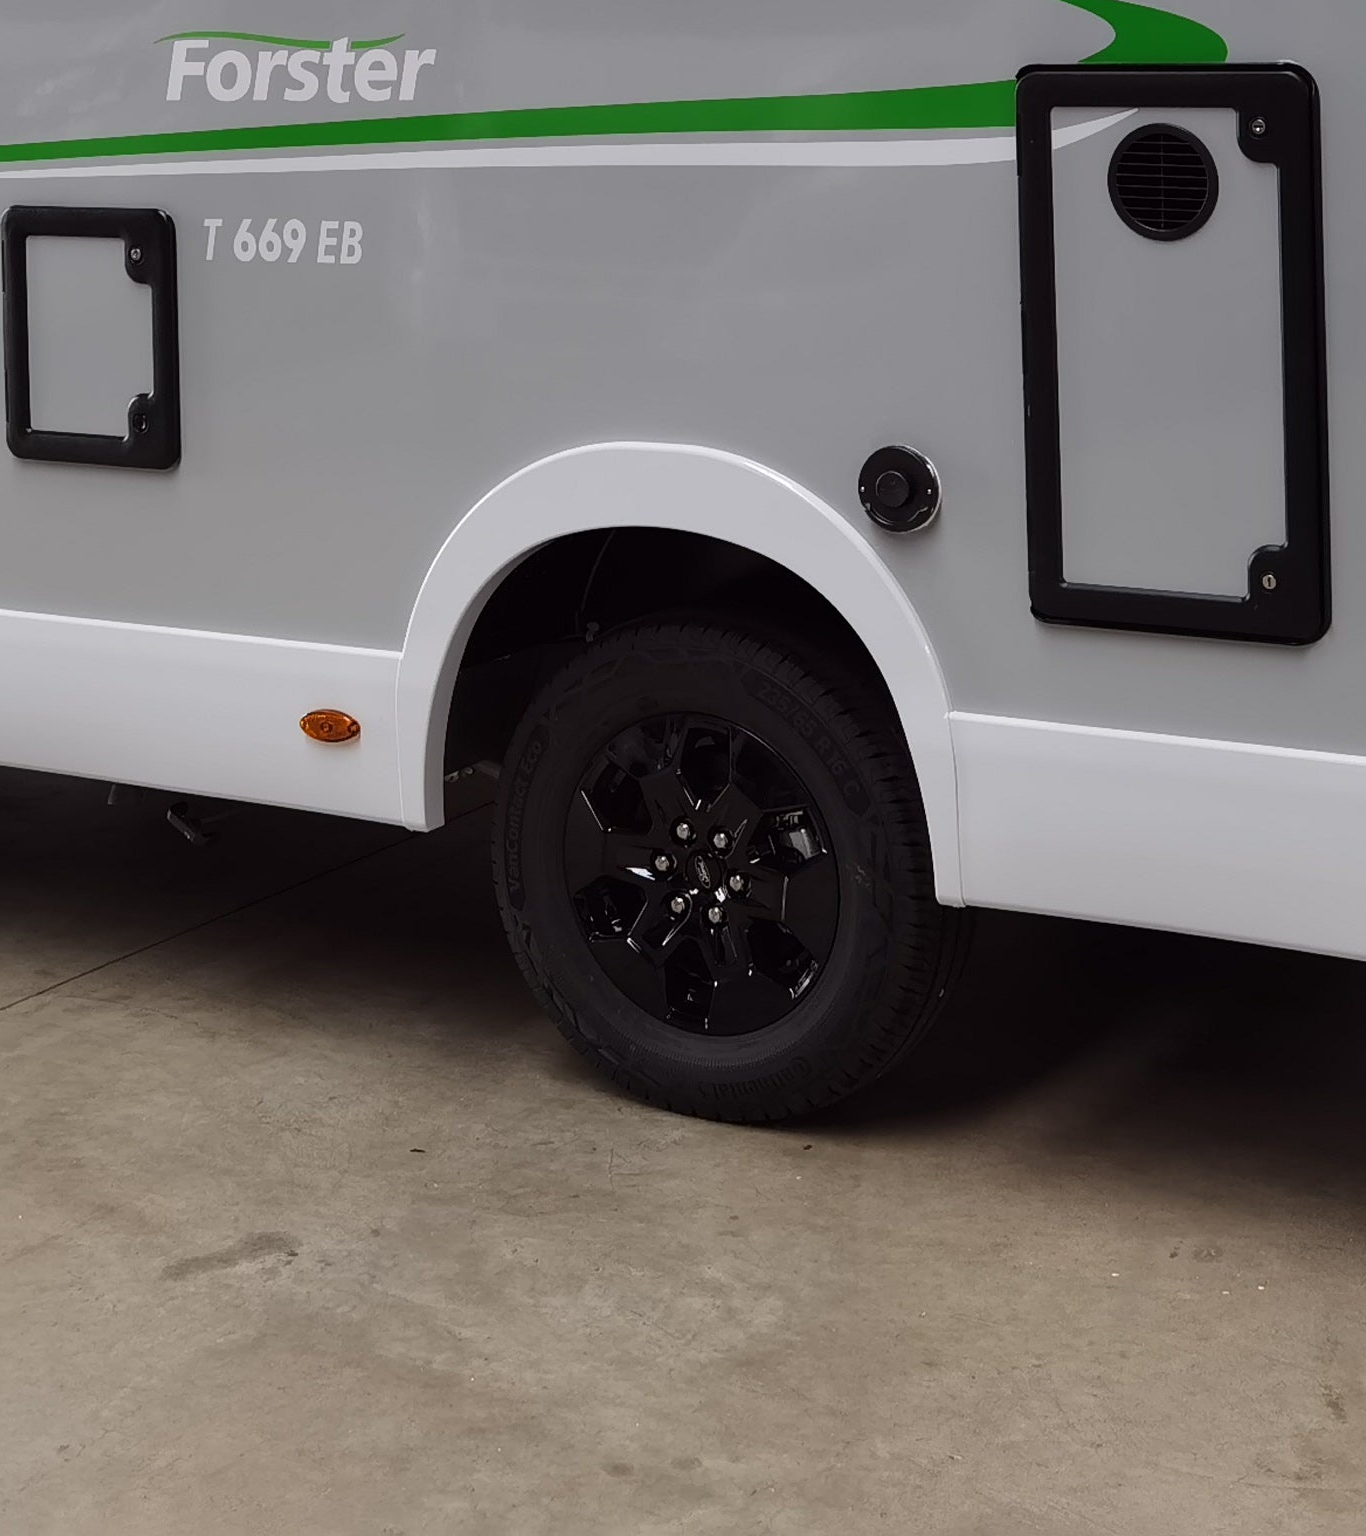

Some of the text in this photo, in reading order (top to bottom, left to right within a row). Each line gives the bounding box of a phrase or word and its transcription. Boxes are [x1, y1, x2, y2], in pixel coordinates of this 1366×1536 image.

[166, 37, 437, 104] Forster
[203, 218, 363, 265] T 669 EB
[758, 680, 860, 796] 235/65 R 16 C
[505, 741, 542, 893] VanContact Eco
